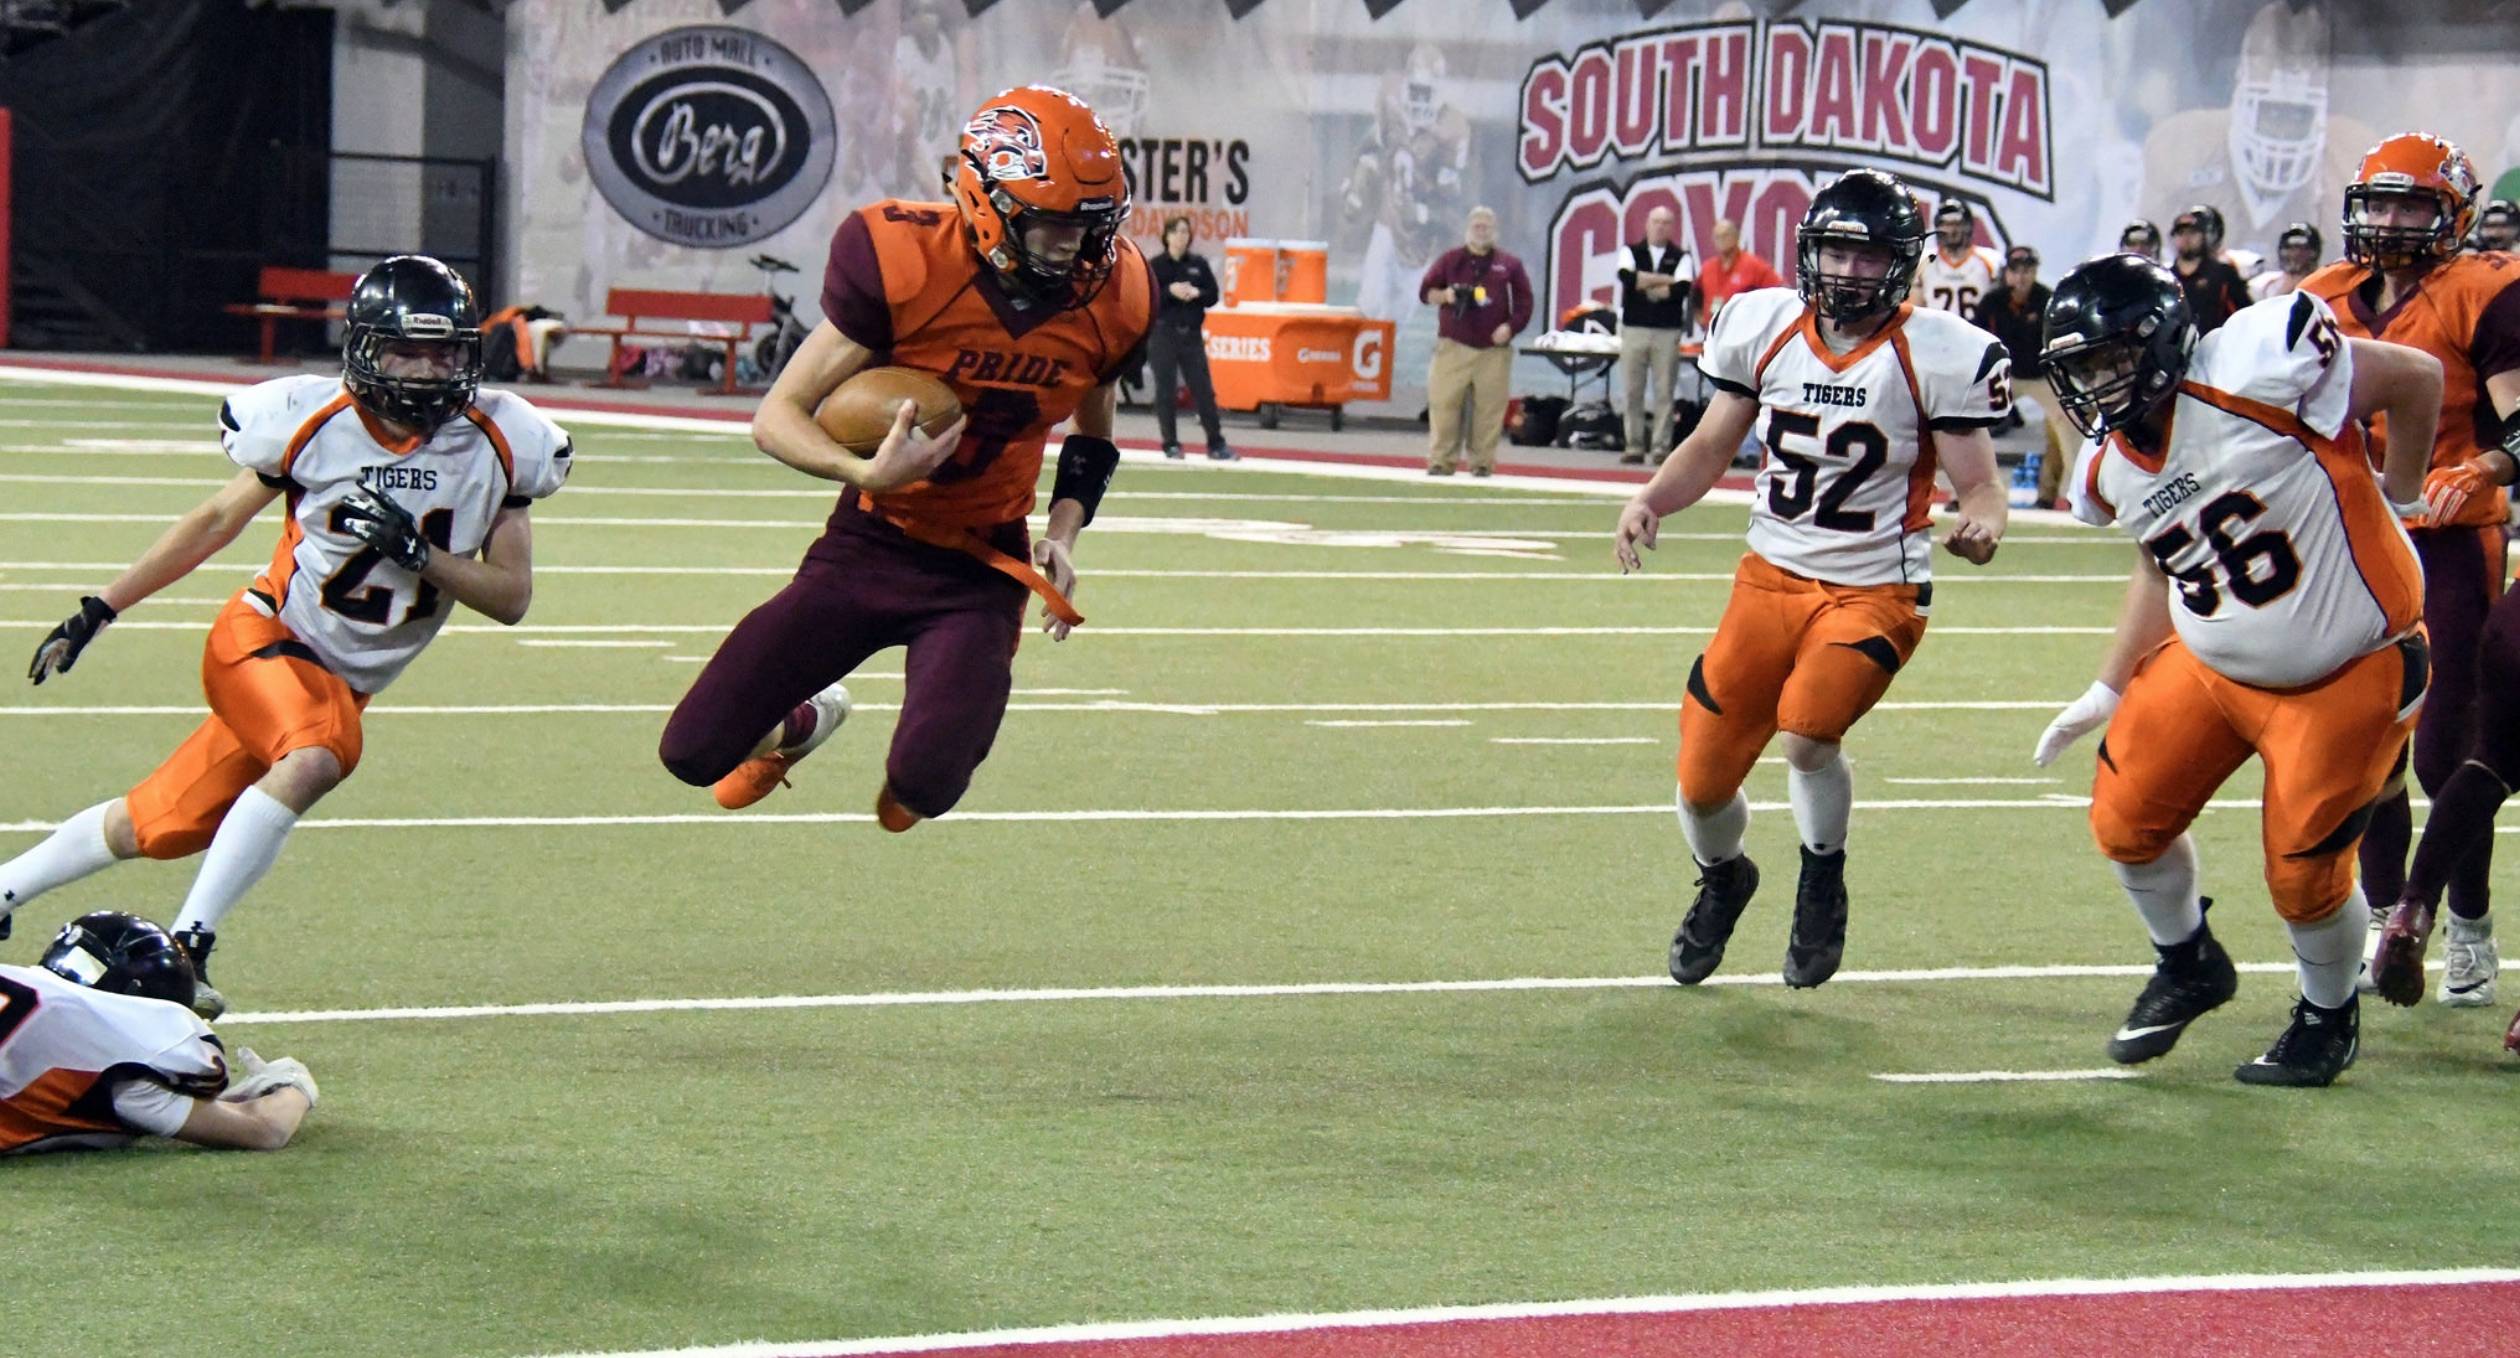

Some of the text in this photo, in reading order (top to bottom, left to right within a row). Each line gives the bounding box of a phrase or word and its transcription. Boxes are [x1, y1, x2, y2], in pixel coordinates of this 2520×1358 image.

[660, 33, 756, 66] AUTO MALL
[1519, 26, 2049, 197] SOUTH DAKOTA
[656, 99, 766, 186] Berg
[1118, 138, 1250, 205] STER'S
[663, 208, 749, 237] TRUCKING
[1933, 286, 1980, 327] 76
[948, 350, 1072, 385] PRIDE
[1206, 336, 1271, 363] SERIES
[1353, 329, 1384, 379] G
[1802, 382, 1868, 408] TIGERS
[1988, 363, 2014, 412] 5
[360, 464, 438, 492] TIGERS
[1765, 407, 1890, 532] 52
[2141, 470, 2202, 521] TIGERS
[2145, 488, 2304, 617] 56
